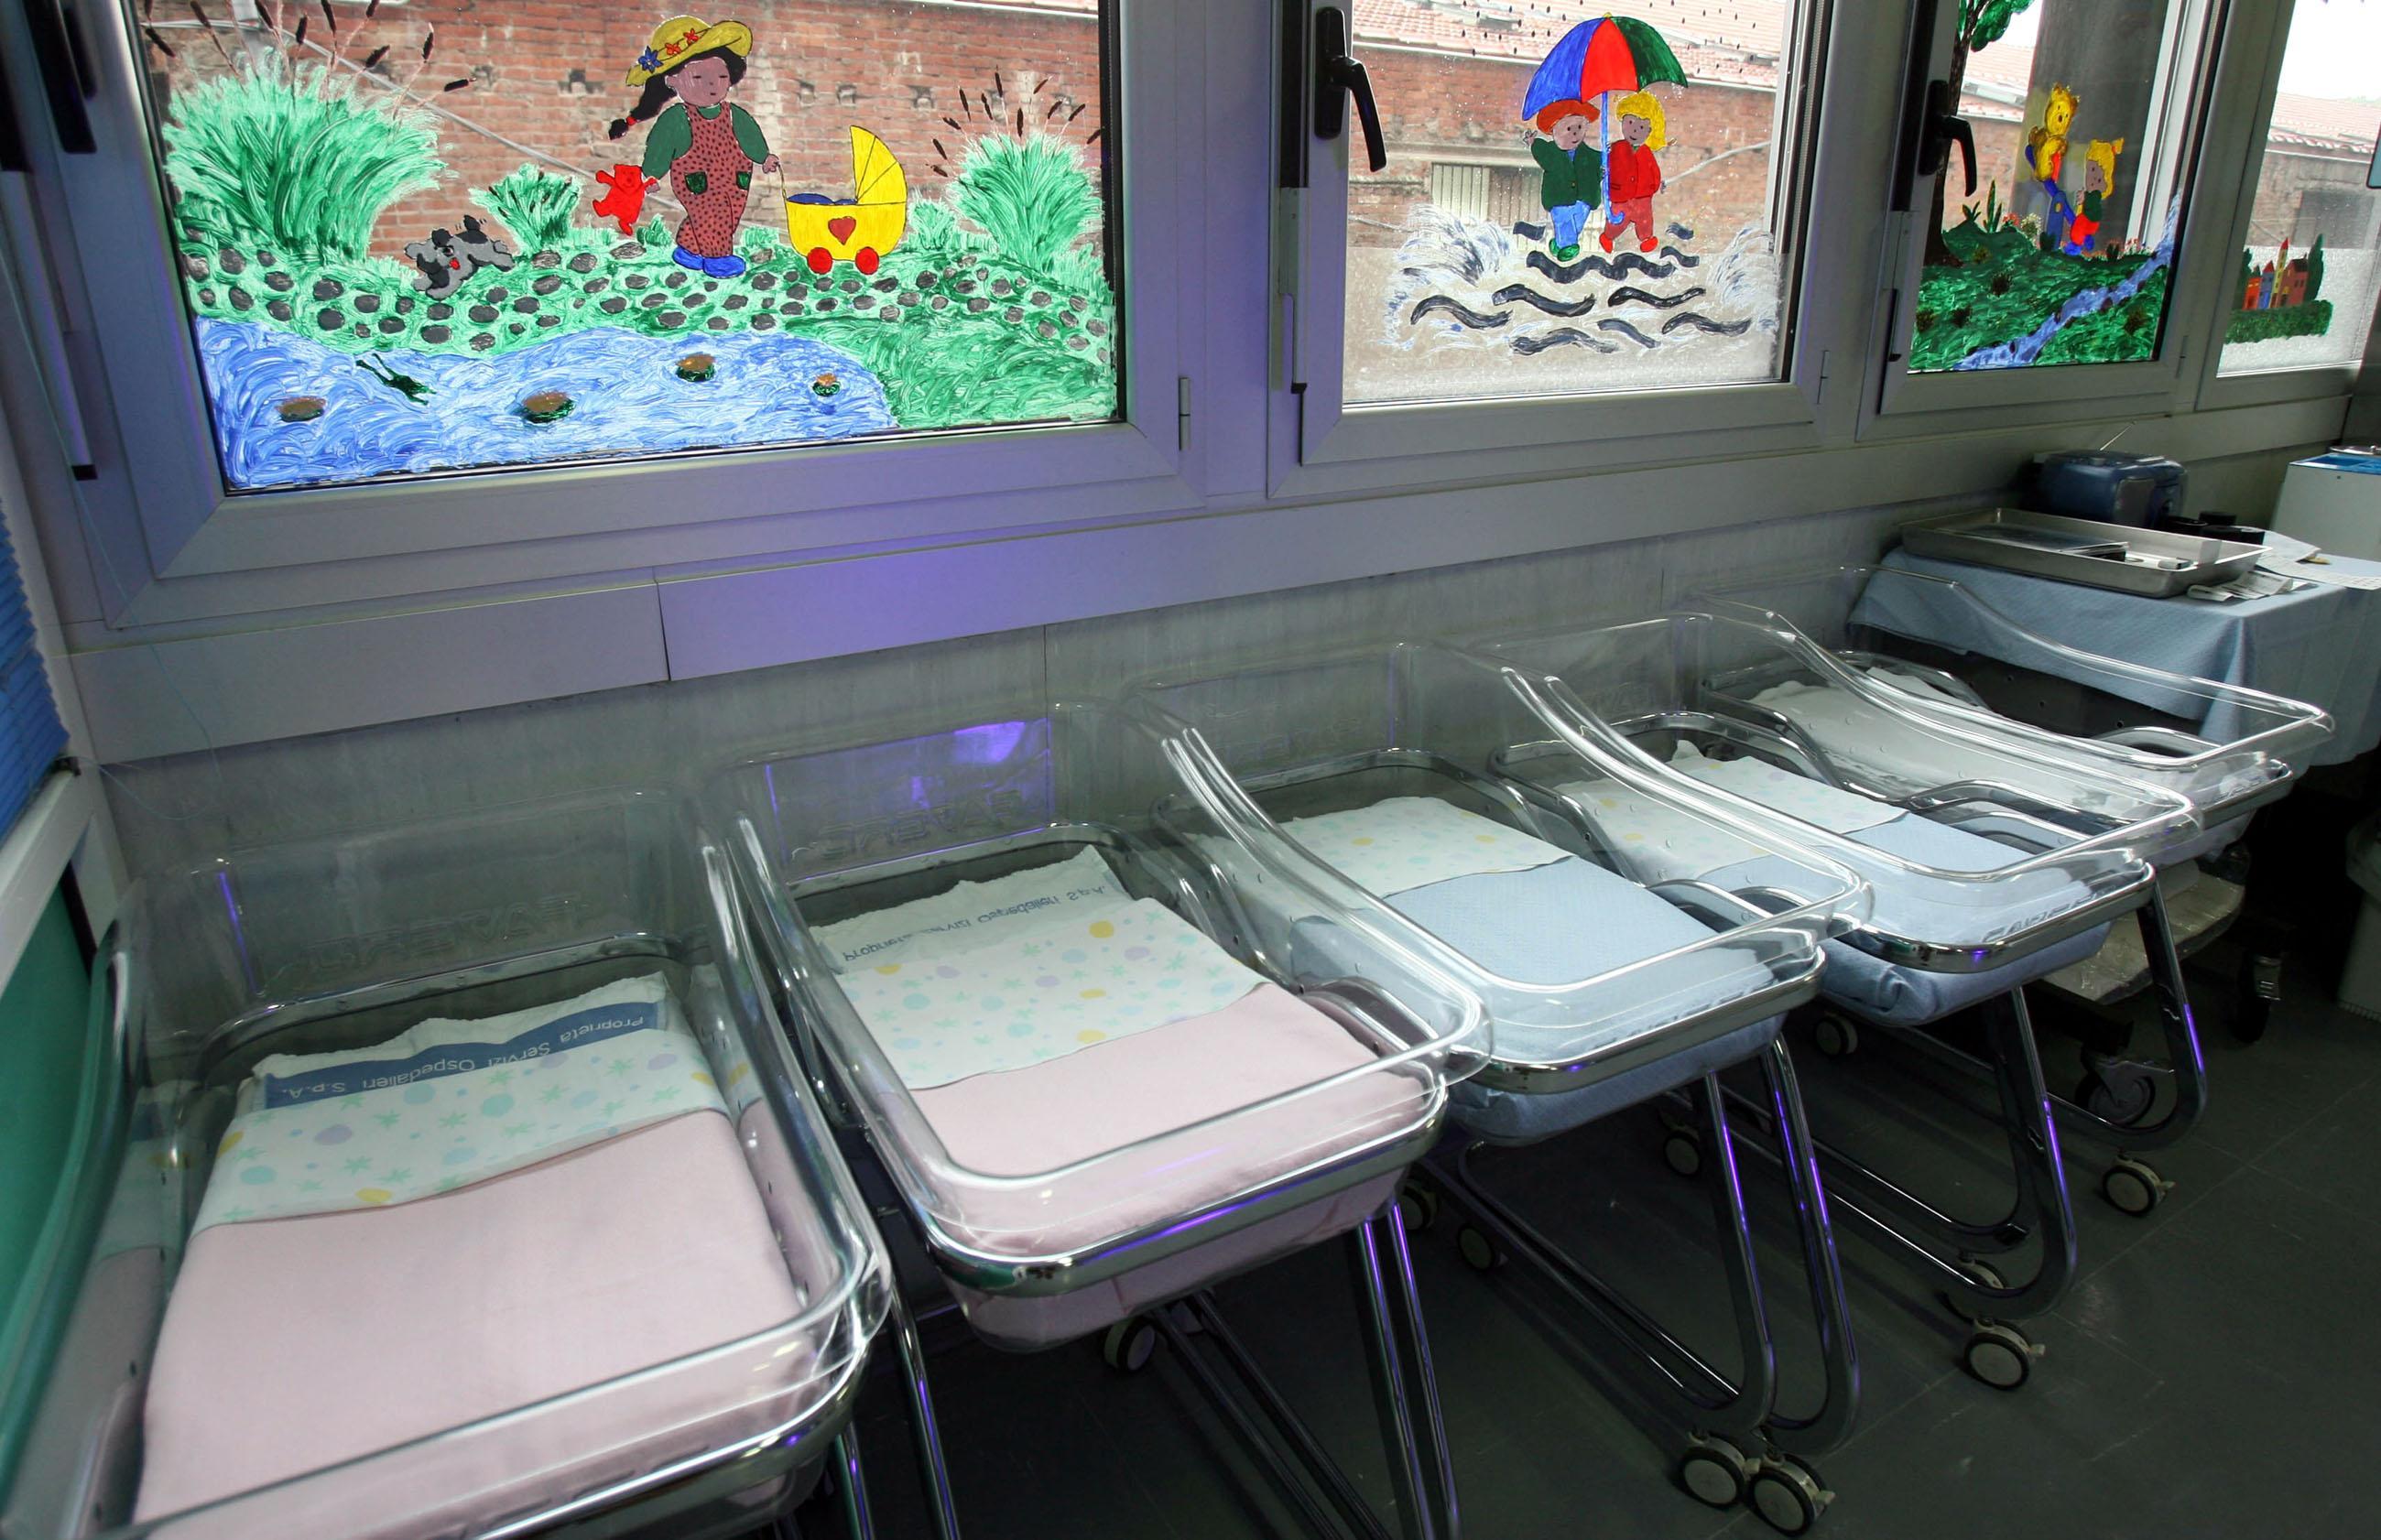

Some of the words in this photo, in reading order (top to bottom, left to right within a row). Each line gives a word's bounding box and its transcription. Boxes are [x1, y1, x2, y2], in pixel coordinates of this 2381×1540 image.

[560, 1016, 644, 1043] Proprieta
[487, 1042, 550, 1068] Servizi
[363, 1058, 475, 1089] Ospedalieri
[282, 1081, 346, 1099] S.p.A.
